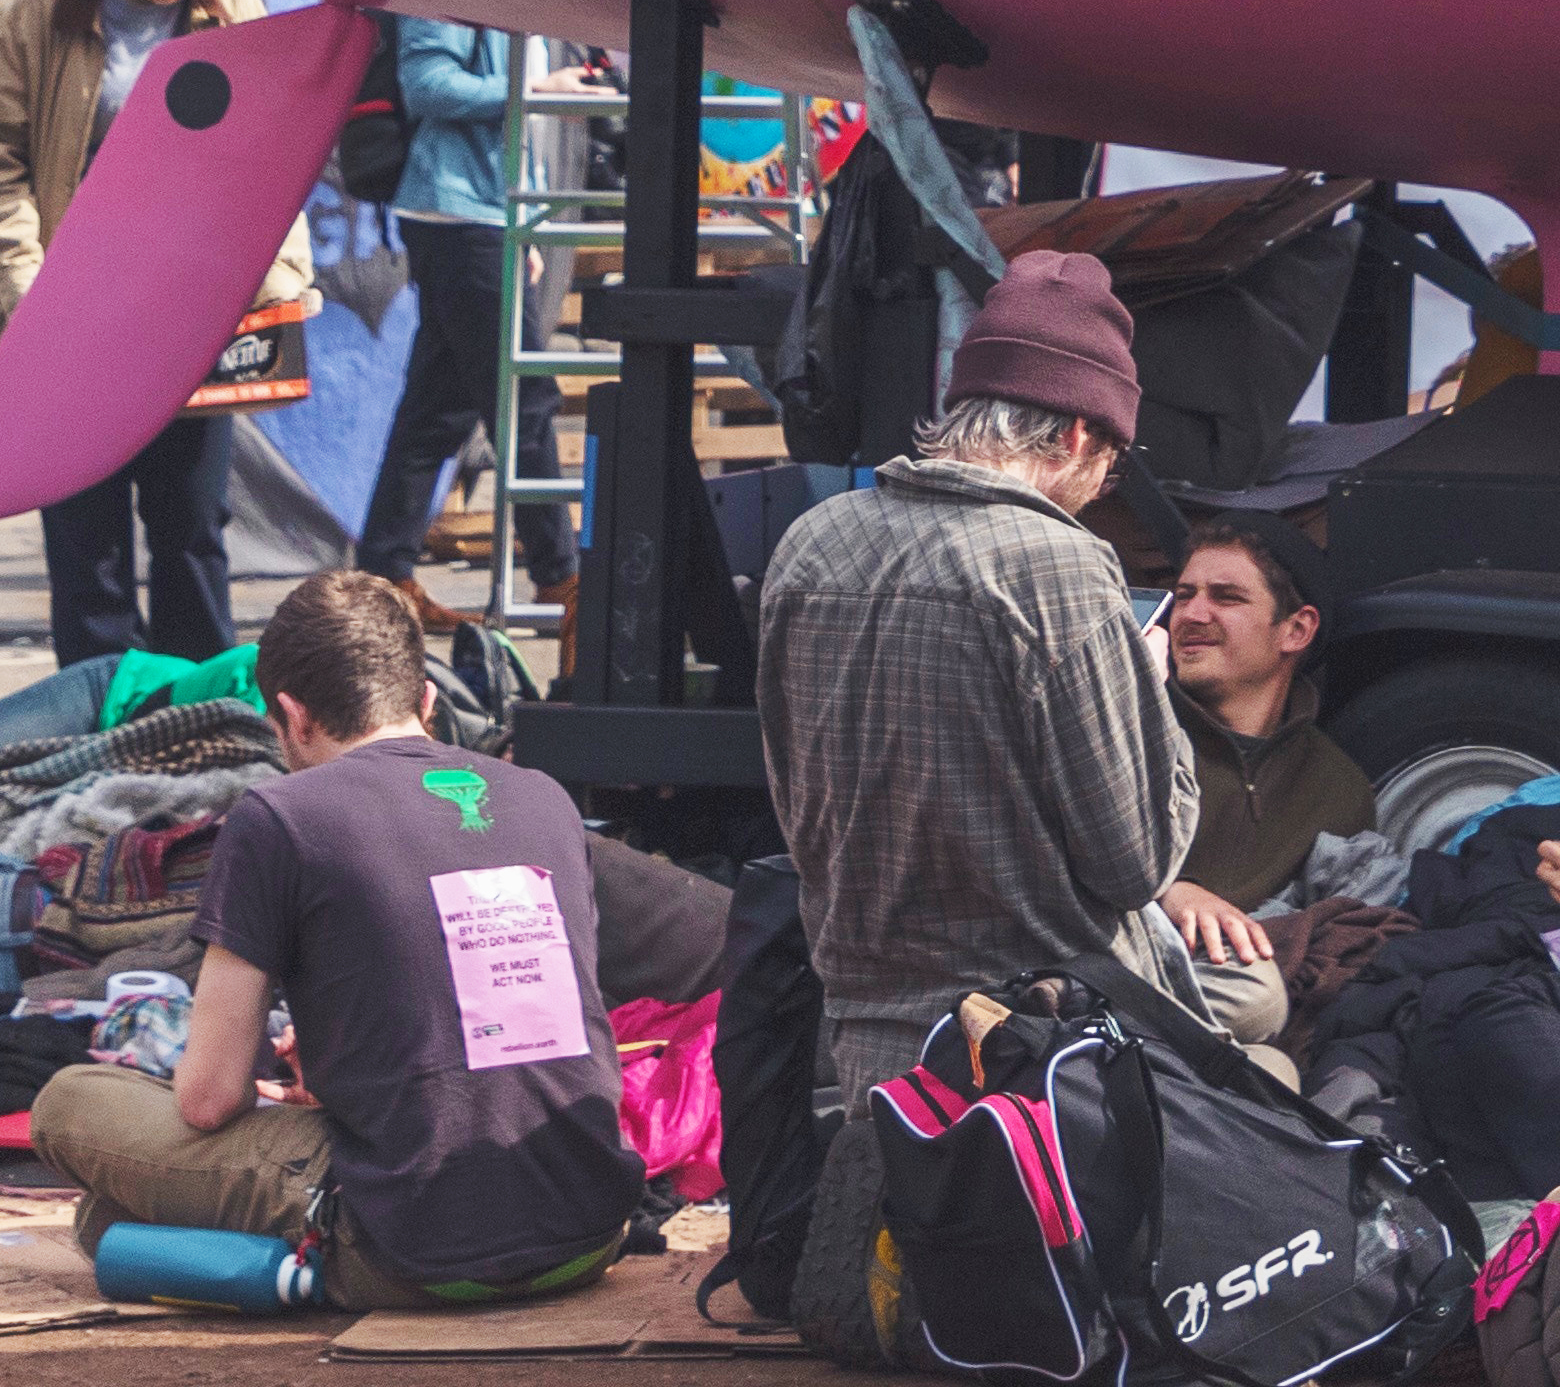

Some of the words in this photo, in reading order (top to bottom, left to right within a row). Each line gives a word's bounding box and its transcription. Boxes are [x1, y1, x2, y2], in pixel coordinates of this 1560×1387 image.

[459, 926, 473, 936] BY
[489, 935, 506, 947] DO
[490, 962, 507, 973] WE
[510, 958, 540, 970] MUST
[493, 976, 514, 987] ACT
